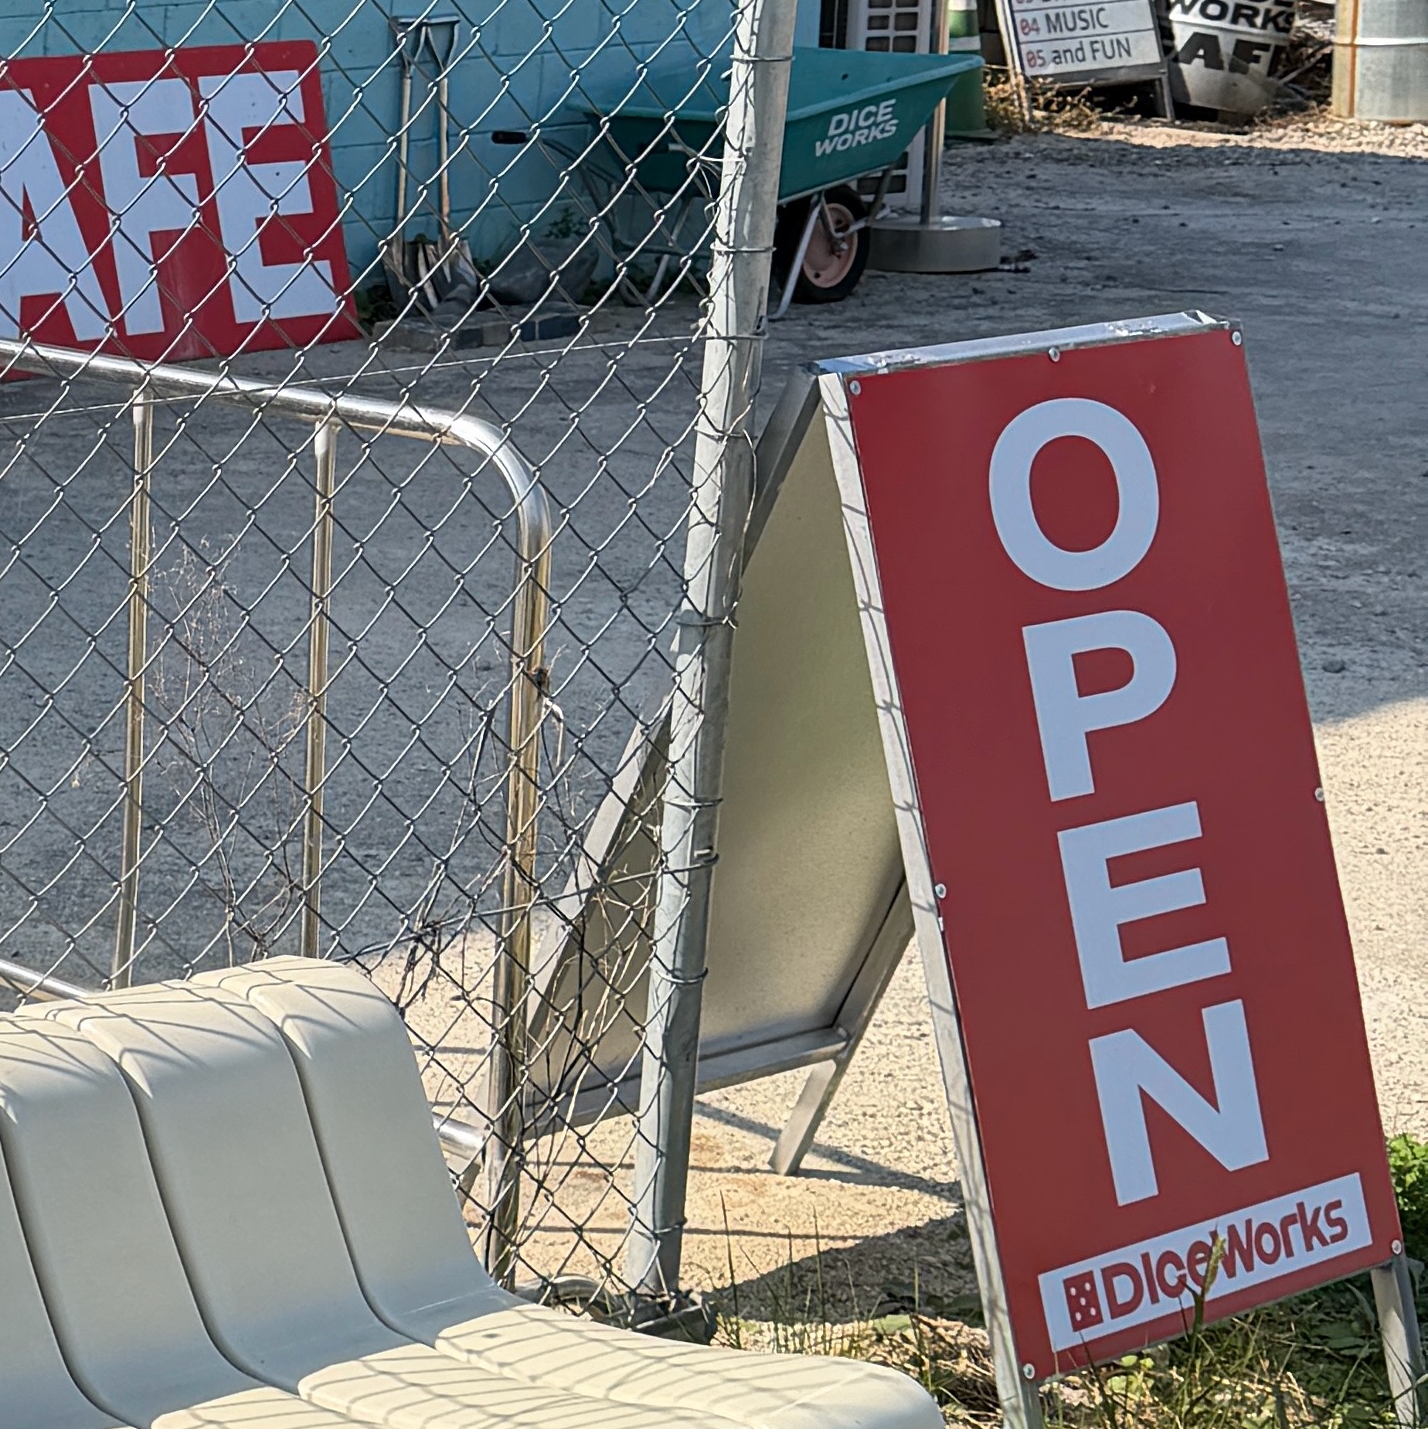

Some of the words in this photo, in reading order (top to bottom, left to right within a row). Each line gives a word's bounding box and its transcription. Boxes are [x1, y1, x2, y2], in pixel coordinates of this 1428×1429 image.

[1045, 8, 1109, 34] MUSIC
[1052, 42, 1086, 65] and
[1090, 36, 1132, 61] FUN
[828, 98, 896, 137] DICE
[815, 119, 900, 157] WORKS
[989, 396, 1270, 1207] OPEN
